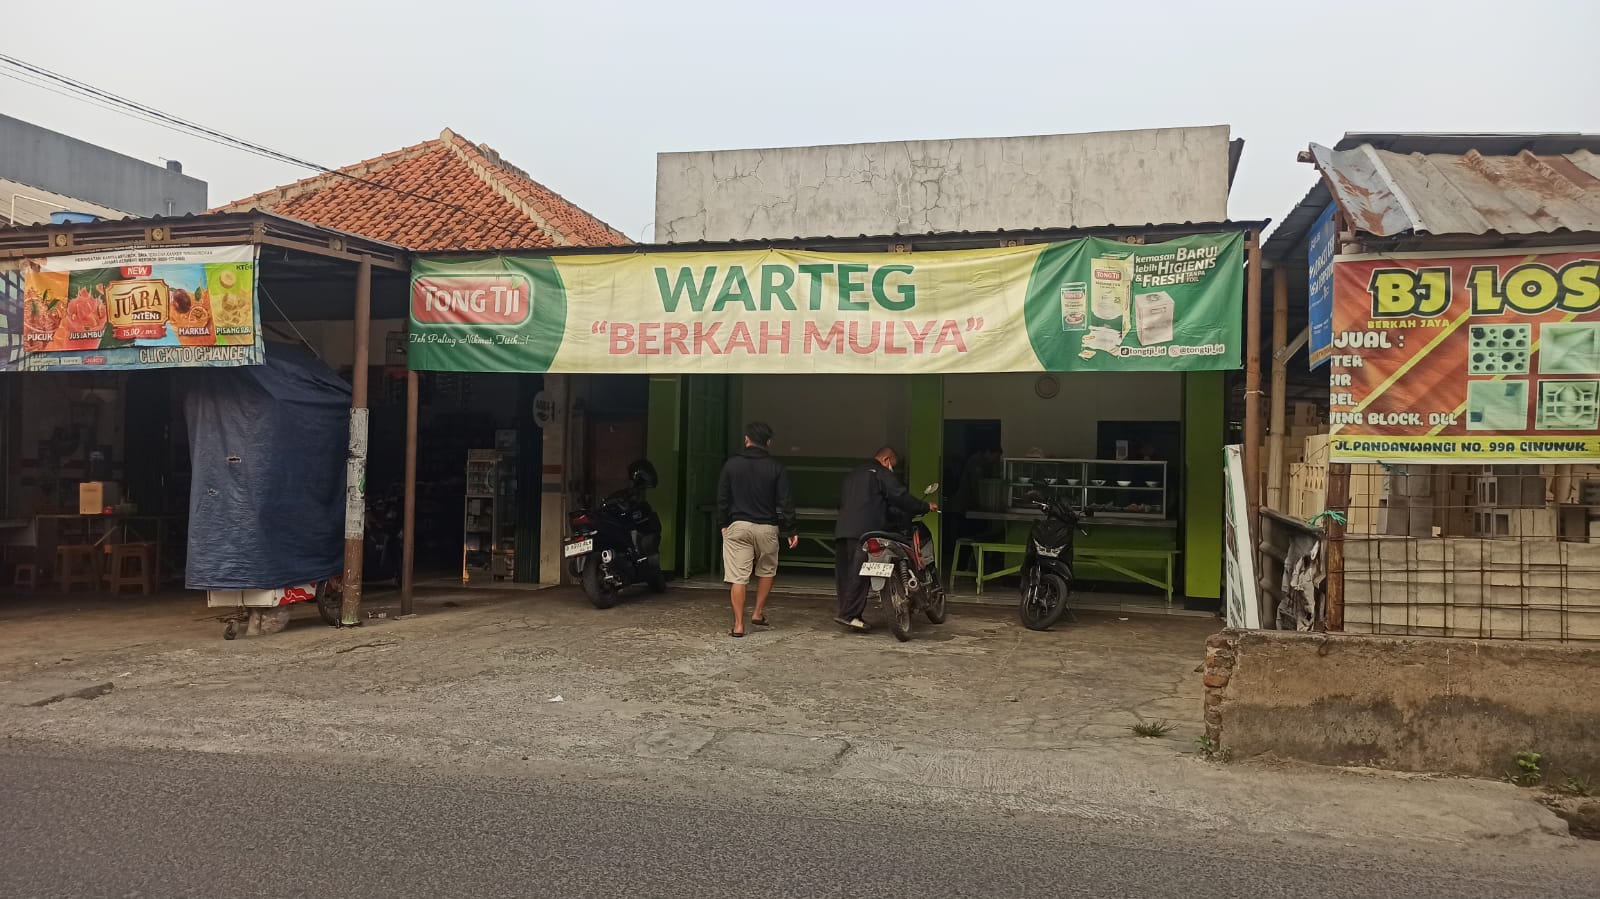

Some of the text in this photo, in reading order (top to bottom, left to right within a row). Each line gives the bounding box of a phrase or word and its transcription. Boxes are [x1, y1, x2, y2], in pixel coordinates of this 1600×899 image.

[1135, 246, 1219, 264] kemasan BARU!
[127, 265, 149, 276] NEW
[1135, 257, 1217, 275] lebih HIGIENIS
[1135, 274, 1143, 282] &
[1142, 273, 1185, 288] FRESH
[654, 264, 917, 313] WARTEG
[1371, 267, 1451, 317] BJ
[114, 288, 162, 319] JUARA
[422, 285, 520, 317] TONG TJI
[132, 311, 160, 321] INTENS
[1367, 318, 1450, 329] BERKAH JAYA
[178, 327, 210, 336] MARKISA
[409, 333, 426, 344] Teh
[428, 333, 457, 348] Paling
[139, 347, 175, 364] CLICK
[176, 347, 193, 362] TO
[1368, 412, 1424, 426] BLOCK,
[1428, 412, 1458, 426] DLL
[1335, 442, 1589, 453] JL.PANDANWANGI NO. 99A CINUNUK.
